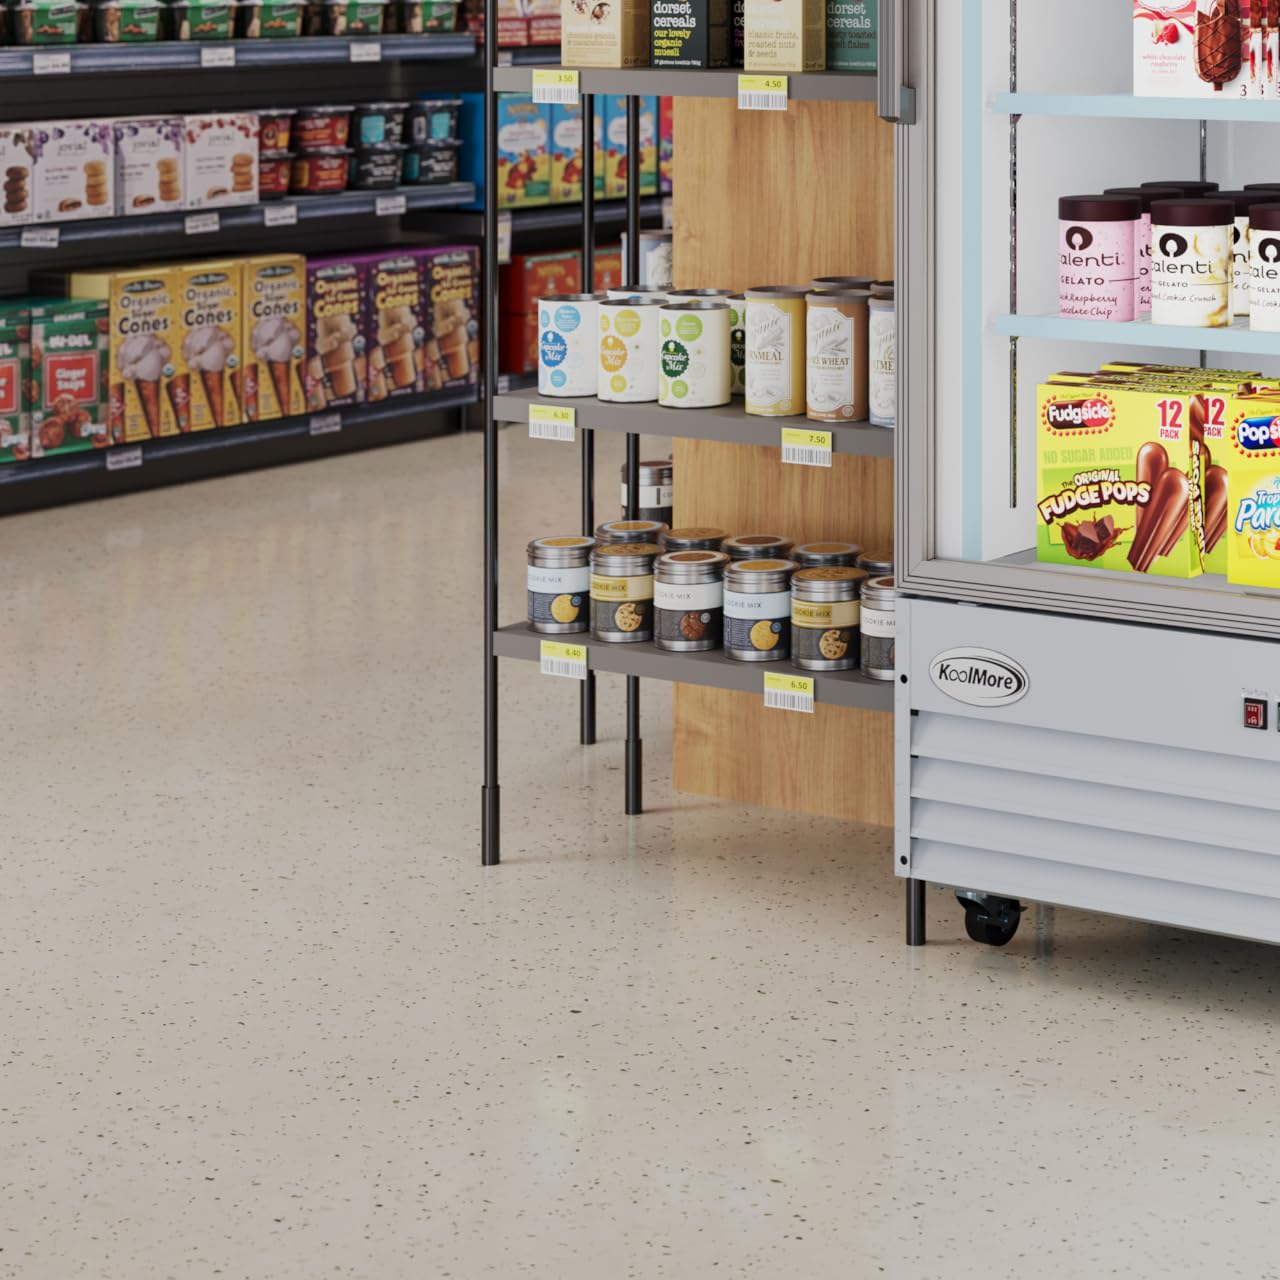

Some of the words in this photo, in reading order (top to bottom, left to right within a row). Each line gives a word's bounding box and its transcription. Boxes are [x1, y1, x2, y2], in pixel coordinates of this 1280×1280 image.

[654, 1, 692, 14] dorset
[827, 2, 866, 15] dorset
[654, 16, 697, 27] cereals
[827, 16, 871, 28] cereals
[654, 30, 667, 38] our
[669, 28, 691, 39] lovely
[654, 39, 683, 48] organic
[748, 40, 777, 48] roasted
[654, 47, 680, 56] muesli
[765, 79, 783, 89] 4.50
[1240, 84, 1247, 96] 3
[1061, 276, 1105, 286] GELATO
[252, 300, 298, 317] Cones
[1090, 307, 1113, 319] Chip
[184, 309, 232, 326] Cones
[119, 317, 168, 334] Cones
[750, 351, 785, 361] NMEAL
[823, 357, 850, 366] WHEAT
[1048, 402, 1110, 424] Fudgsicle
[1157, 399, 1183, 429] 12
[1203, 398, 1226, 426] 12
[1160, 429, 1180, 439] PACK
[1203, 426, 1223, 437] PACK
[809, 435, 826, 445] 7.50
[1044, 450, 1058, 464] NO
[1061, 448, 1096, 463] SUGAR
[1100, 447, 1134, 461] ADDED
[1073, 469, 1120, 487] ORIGINAL
[1038, 483, 1101, 523] FUDGE
[1101, 482, 1152, 505] POPS
[549, 576, 562, 584] MIX
[612, 584, 627, 592] MIX
[677, 592, 692, 600] MIX
[747, 601, 762, 609] MIX
[815, 609, 831, 618] MIX
[886, 619, 896, 627] MI
[938, 663, 1014, 691] KoolMore
[791, 680, 808, 690] 6.50
